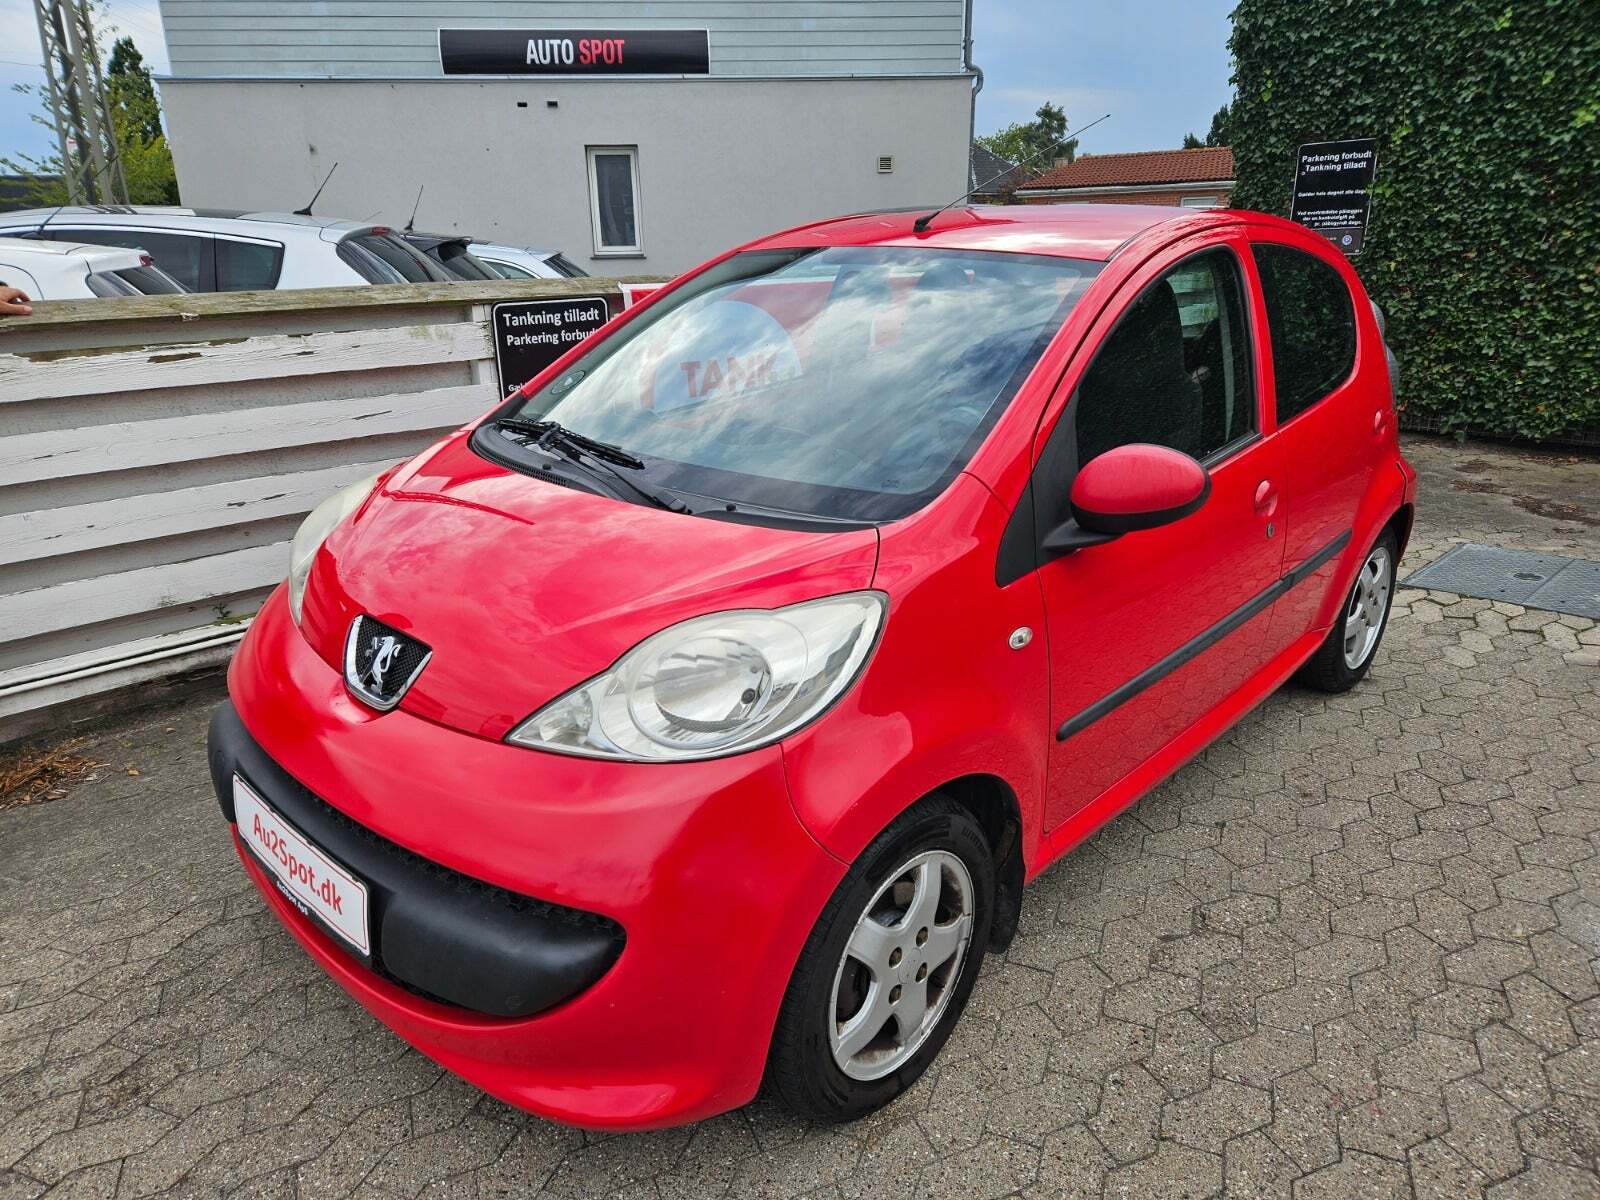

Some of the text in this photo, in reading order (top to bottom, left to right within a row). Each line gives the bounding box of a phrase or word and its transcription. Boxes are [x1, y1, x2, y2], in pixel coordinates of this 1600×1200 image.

[526, 39, 625, 65] AUTO SPOT
[1302, 150, 1372, 163] Parkering forbudt
[1305, 161, 1367, 172] Tankning tilladt
[503, 308, 600, 326] Tankning tilladt
[507, 332, 559, 346] Parkering
[681, 353, 777, 398] TANK
[253, 813, 343, 916] Au2Spot.dk
